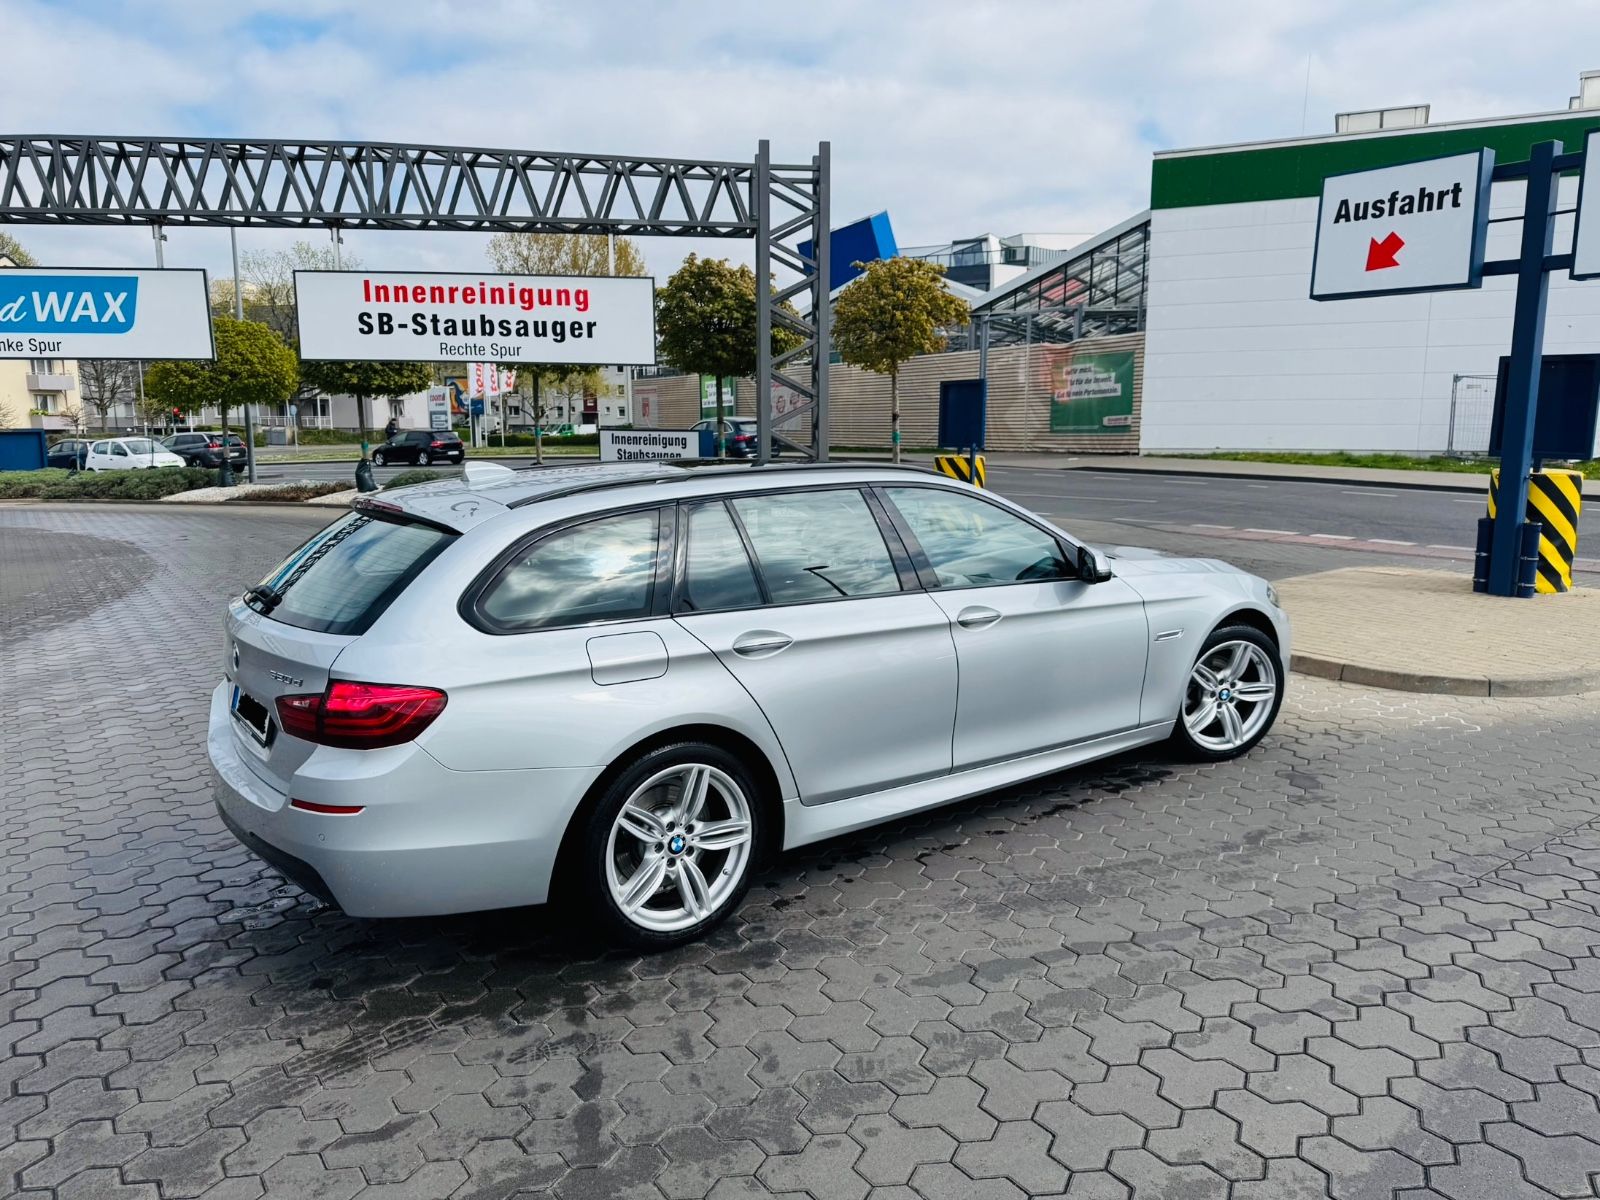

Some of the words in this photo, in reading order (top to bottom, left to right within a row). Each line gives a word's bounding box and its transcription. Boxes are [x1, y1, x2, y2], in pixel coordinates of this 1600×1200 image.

[1333, 182, 1463, 224] Ausfahrt
[31, 291, 128, 323] WAX
[363, 279, 590, 312] Innenreinigung
[357, 311, 598, 343] SB-Staubsauger
[28, 338, 62, 354] Spur
[439, 342, 487, 356] Rechte
[490, 343, 523, 358] Spur
[611, 432, 687, 449] Innenreinigung
